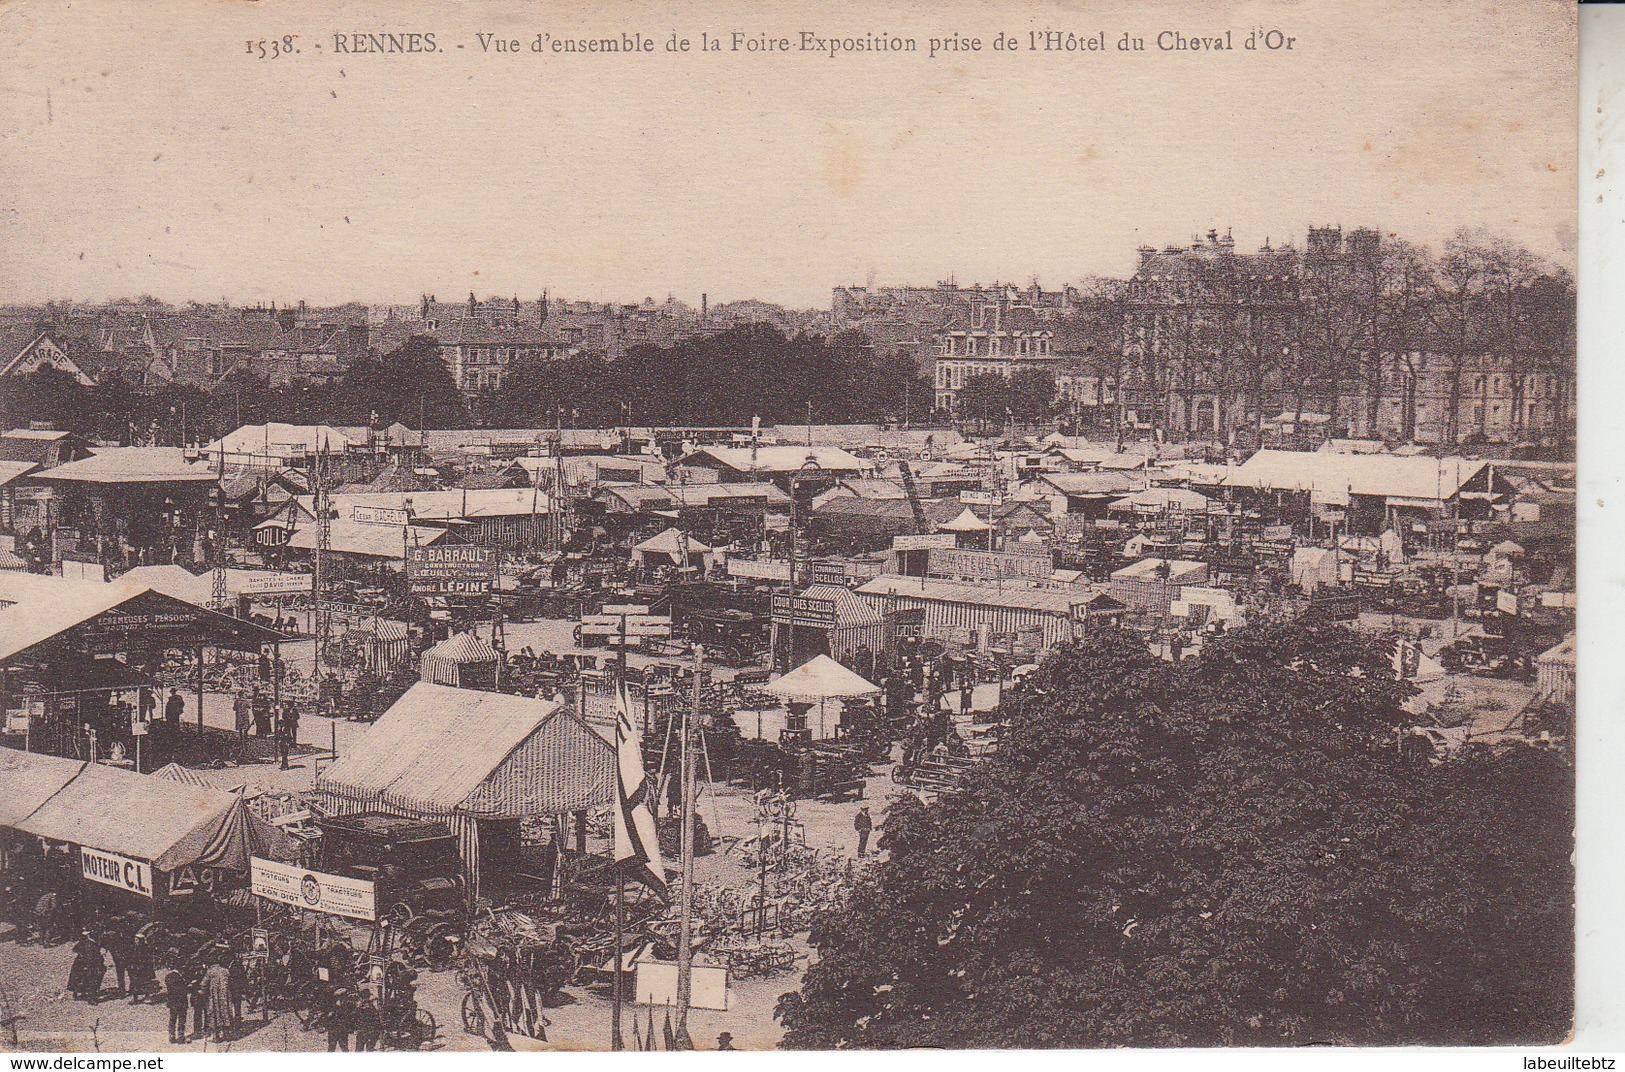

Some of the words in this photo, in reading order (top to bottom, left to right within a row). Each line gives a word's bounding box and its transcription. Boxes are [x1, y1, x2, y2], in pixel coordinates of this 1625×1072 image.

[25, 347, 68, 366] GARAGE
[257, 528, 288, 546] DOLLE
[428, 548, 490, 562] BARRAULT
[814, 574, 844, 584] SCELLOS
[330, 603, 358, 614] DOLLE
[83, 852, 121, 883] MOTEUR
[123, 861, 149, 893] C.L.
